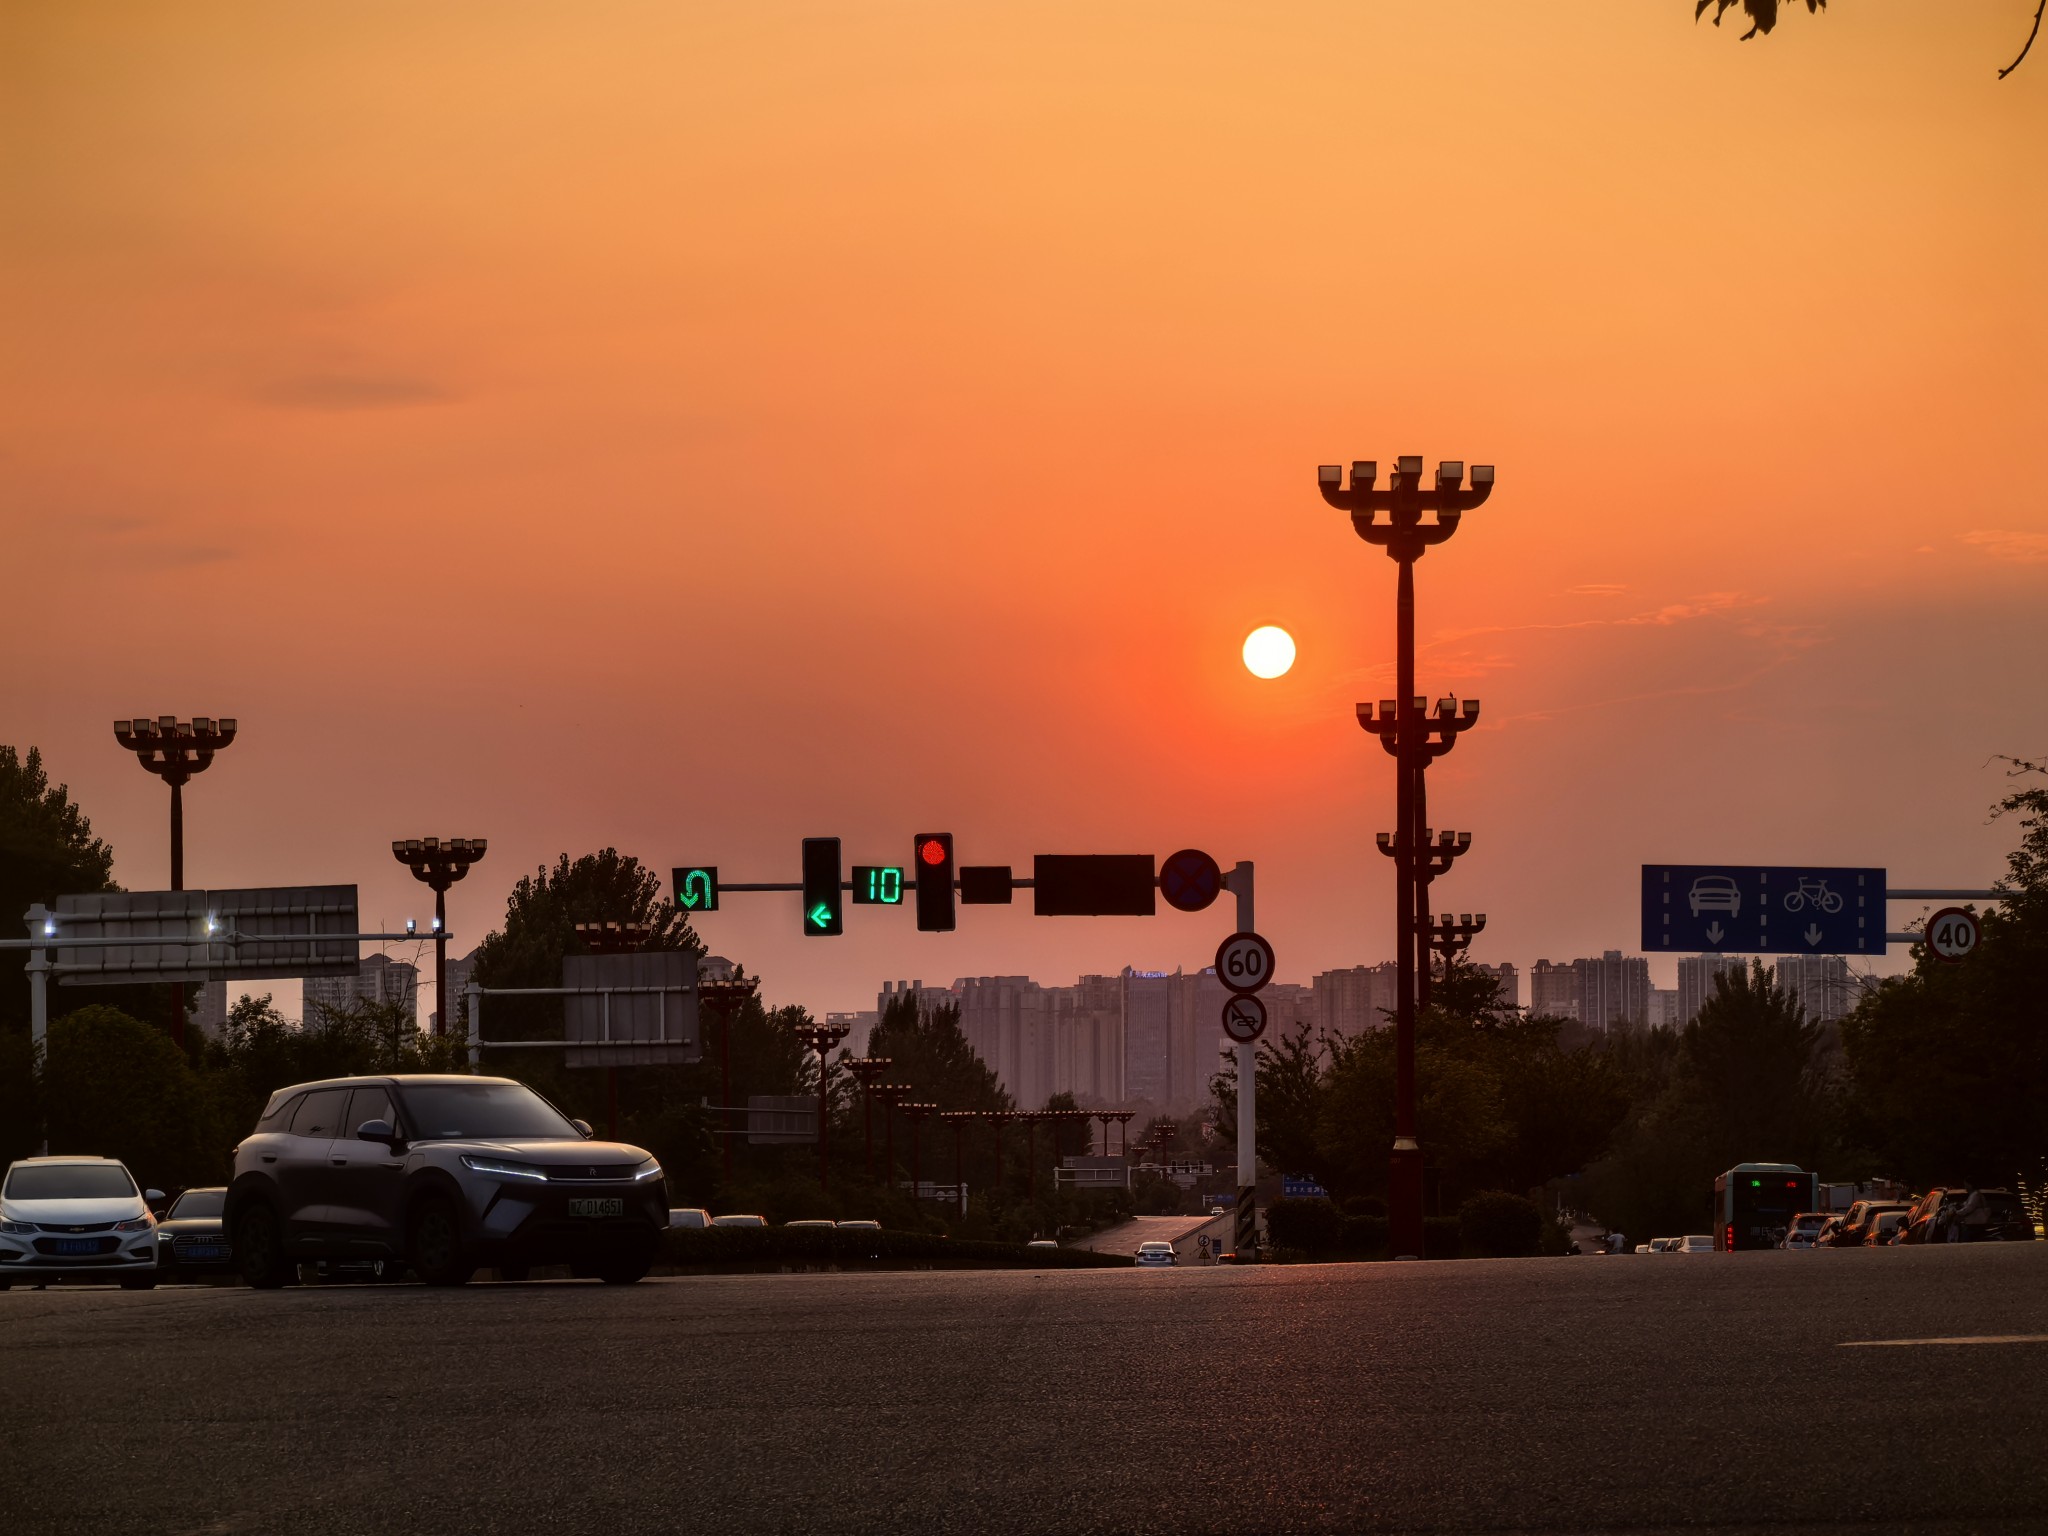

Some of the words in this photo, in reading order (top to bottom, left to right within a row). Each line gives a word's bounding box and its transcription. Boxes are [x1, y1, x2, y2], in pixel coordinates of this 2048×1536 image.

[870, 868, 900, 903] 10
[1937, 923, 1970, 948] 40
[1228, 949, 1261, 977] 60
